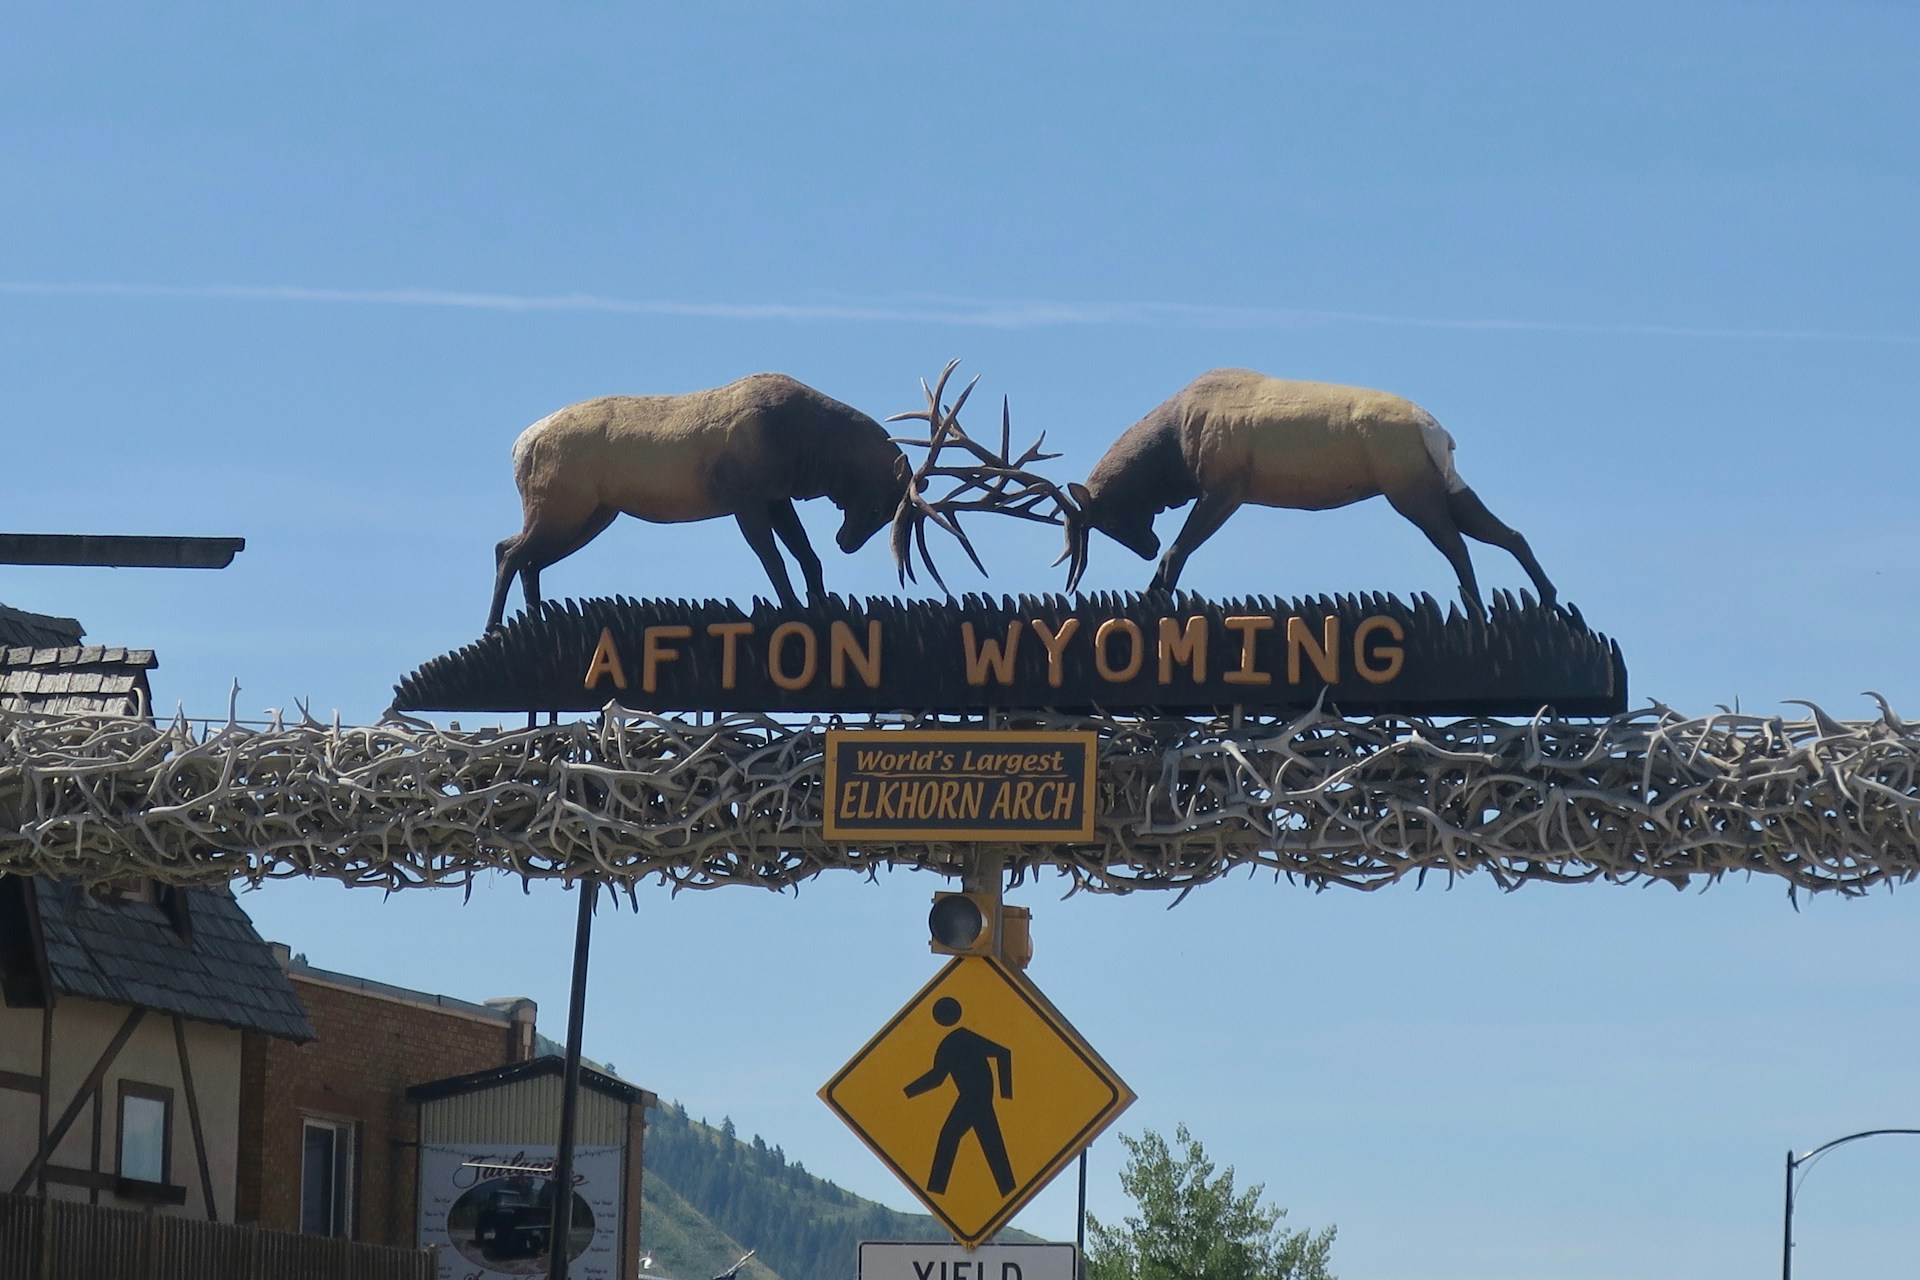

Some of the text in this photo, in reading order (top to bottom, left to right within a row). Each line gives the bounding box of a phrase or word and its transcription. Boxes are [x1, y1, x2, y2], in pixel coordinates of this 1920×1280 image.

[584, 615, 1405, 693] AFTON WYOMING
[857, 750, 1065, 773] World's Largest
[840, 781, 1076, 820] ELKHORN ARCH
